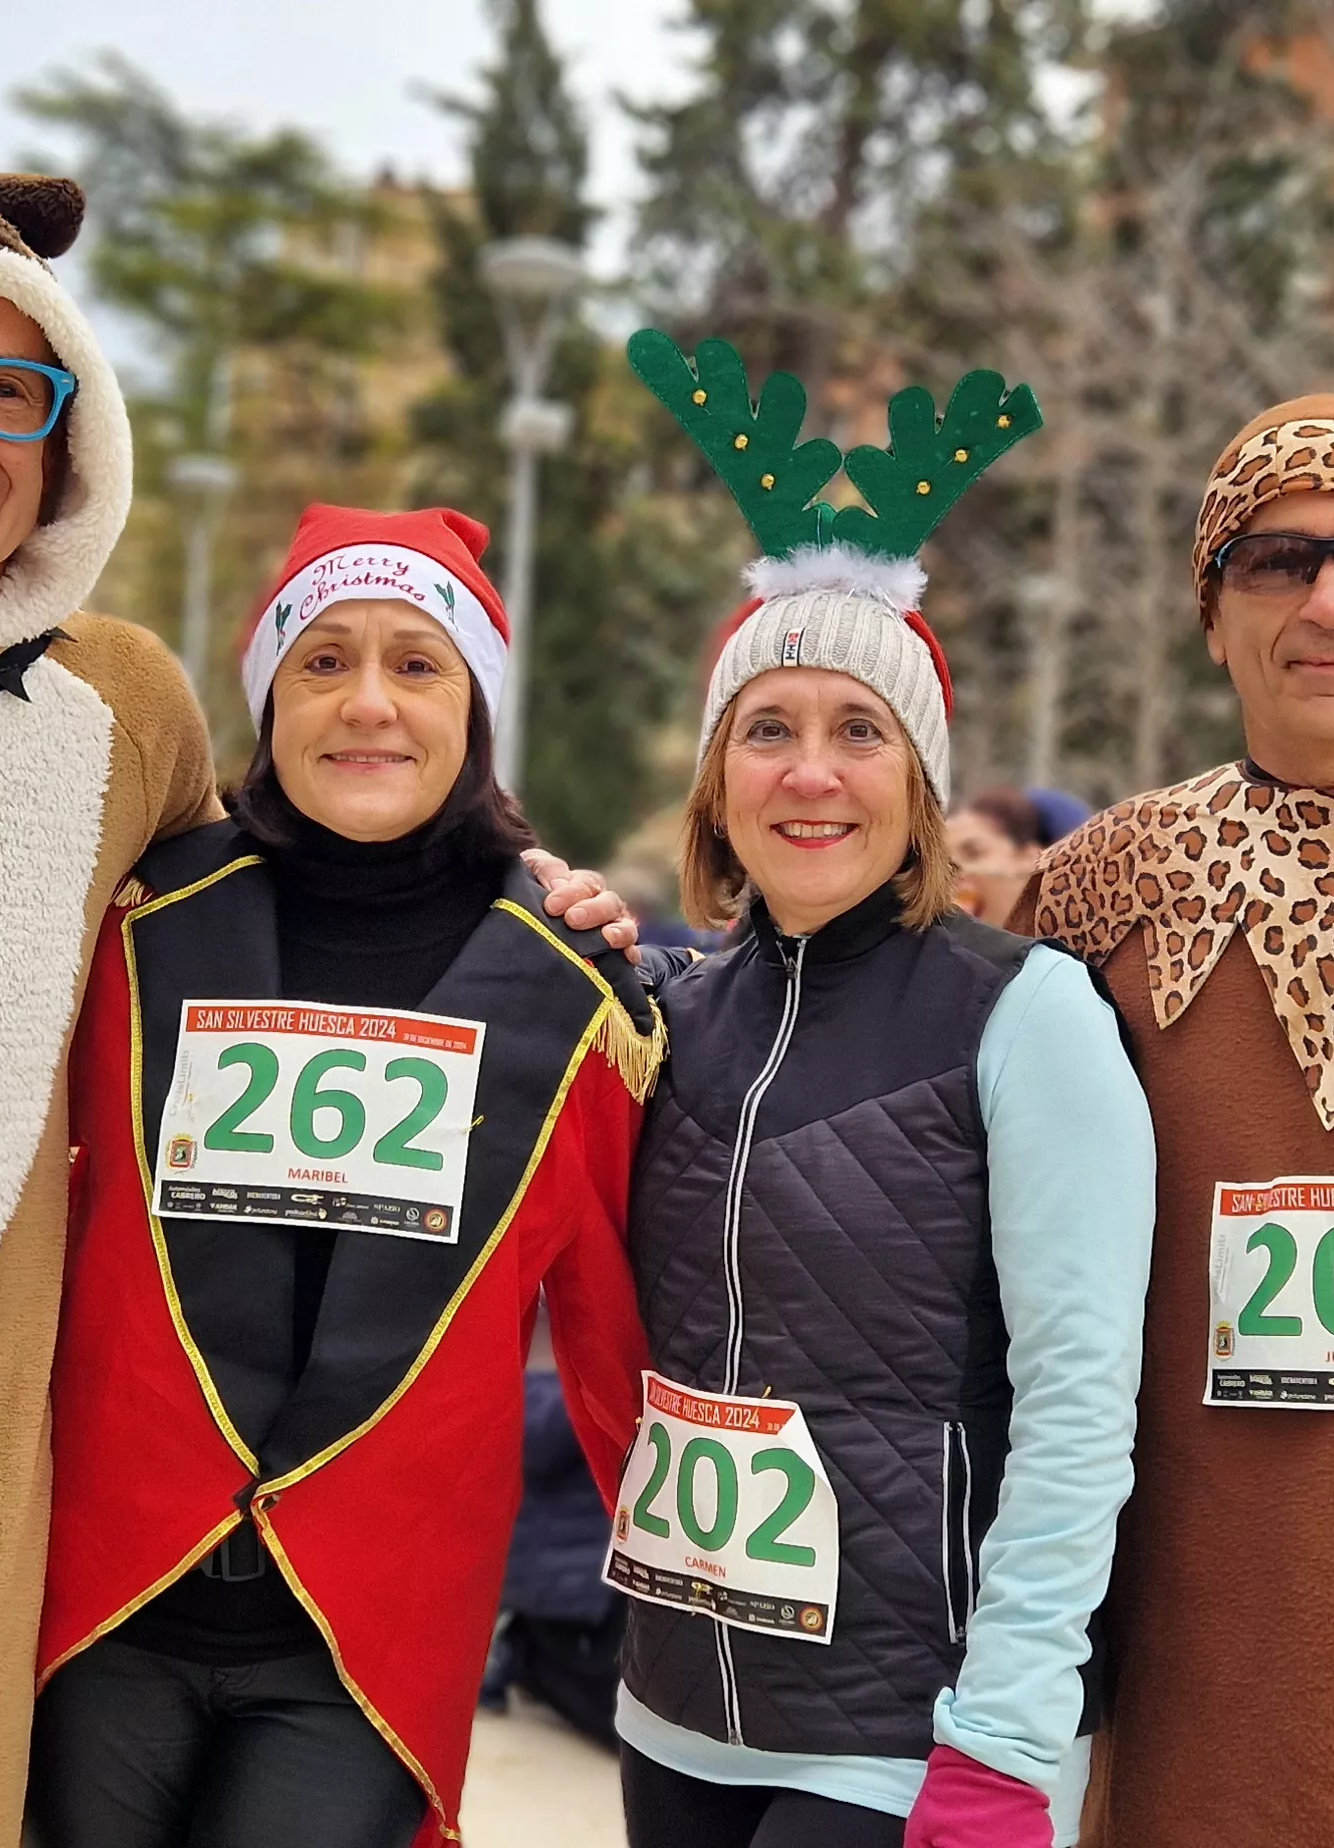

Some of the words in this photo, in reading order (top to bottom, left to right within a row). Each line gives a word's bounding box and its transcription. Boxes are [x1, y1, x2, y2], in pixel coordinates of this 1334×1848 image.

[312, 553, 410, 585] Merry
[299, 571, 427, 621] Christmas
[196, 1009, 222, 1029] SAN
[226, 1010, 295, 1031] SILVESTRE
[298, 1012, 356, 1036] HUESCA
[359, 1018, 397, 1040] 2024
[203, 1042, 450, 1172] 262
[287, 1168, 349, 1184] MARIBEL
[1232, 1194, 1252, 1213] SAN
[682, 1396, 721, 1425] HUESCA
[725, 1406, 760, 1429] 2024
[633, 1421, 817, 1568] 202
[685, 1556, 726, 1578] CARMEN
